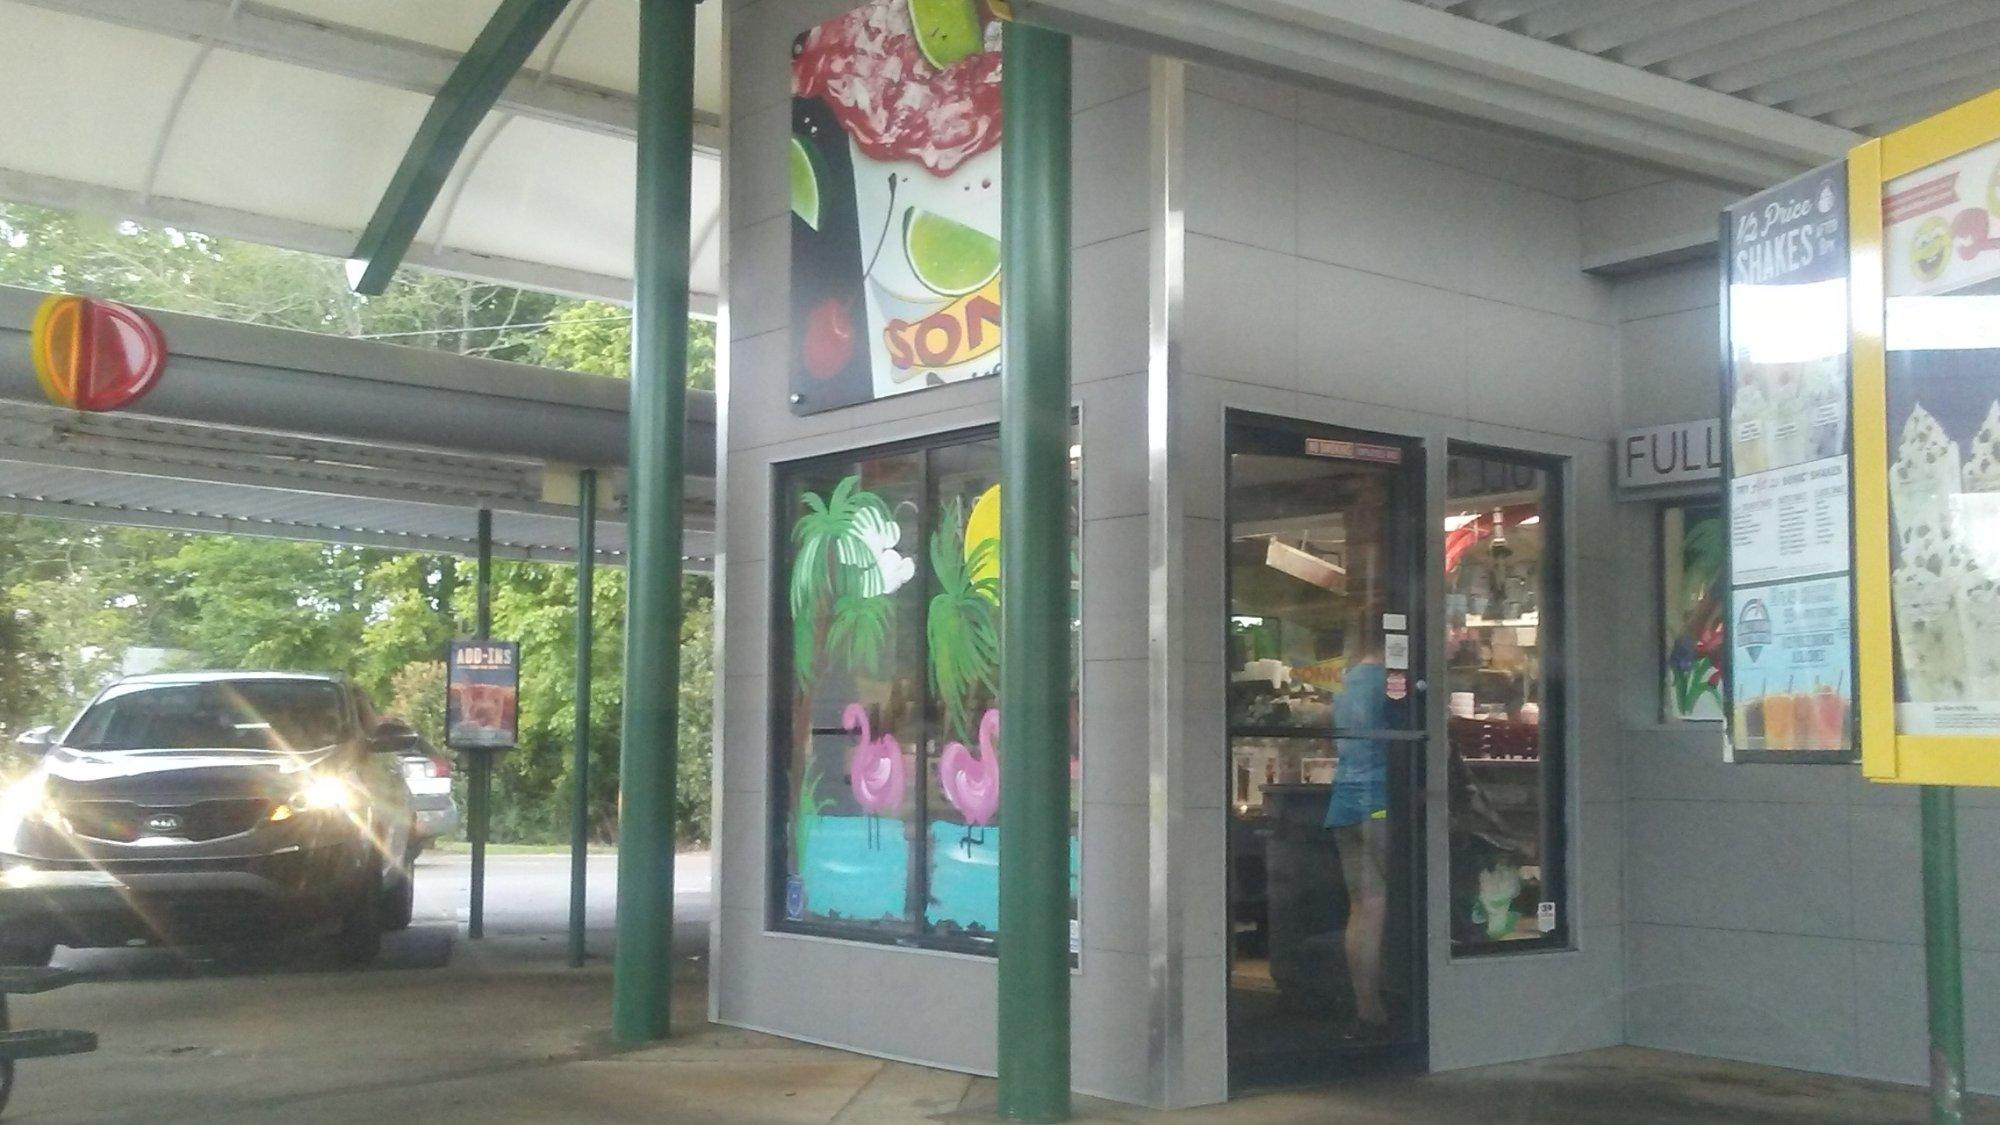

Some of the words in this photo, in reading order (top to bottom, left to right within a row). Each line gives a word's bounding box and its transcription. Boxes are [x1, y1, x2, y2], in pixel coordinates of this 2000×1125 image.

[1761, 199, 1814, 237] Price
[1735, 224, 1814, 283] SHAKES
[1626, 427, 1722, 478] FULL
[456, 646, 512, 665] ADD-INS
